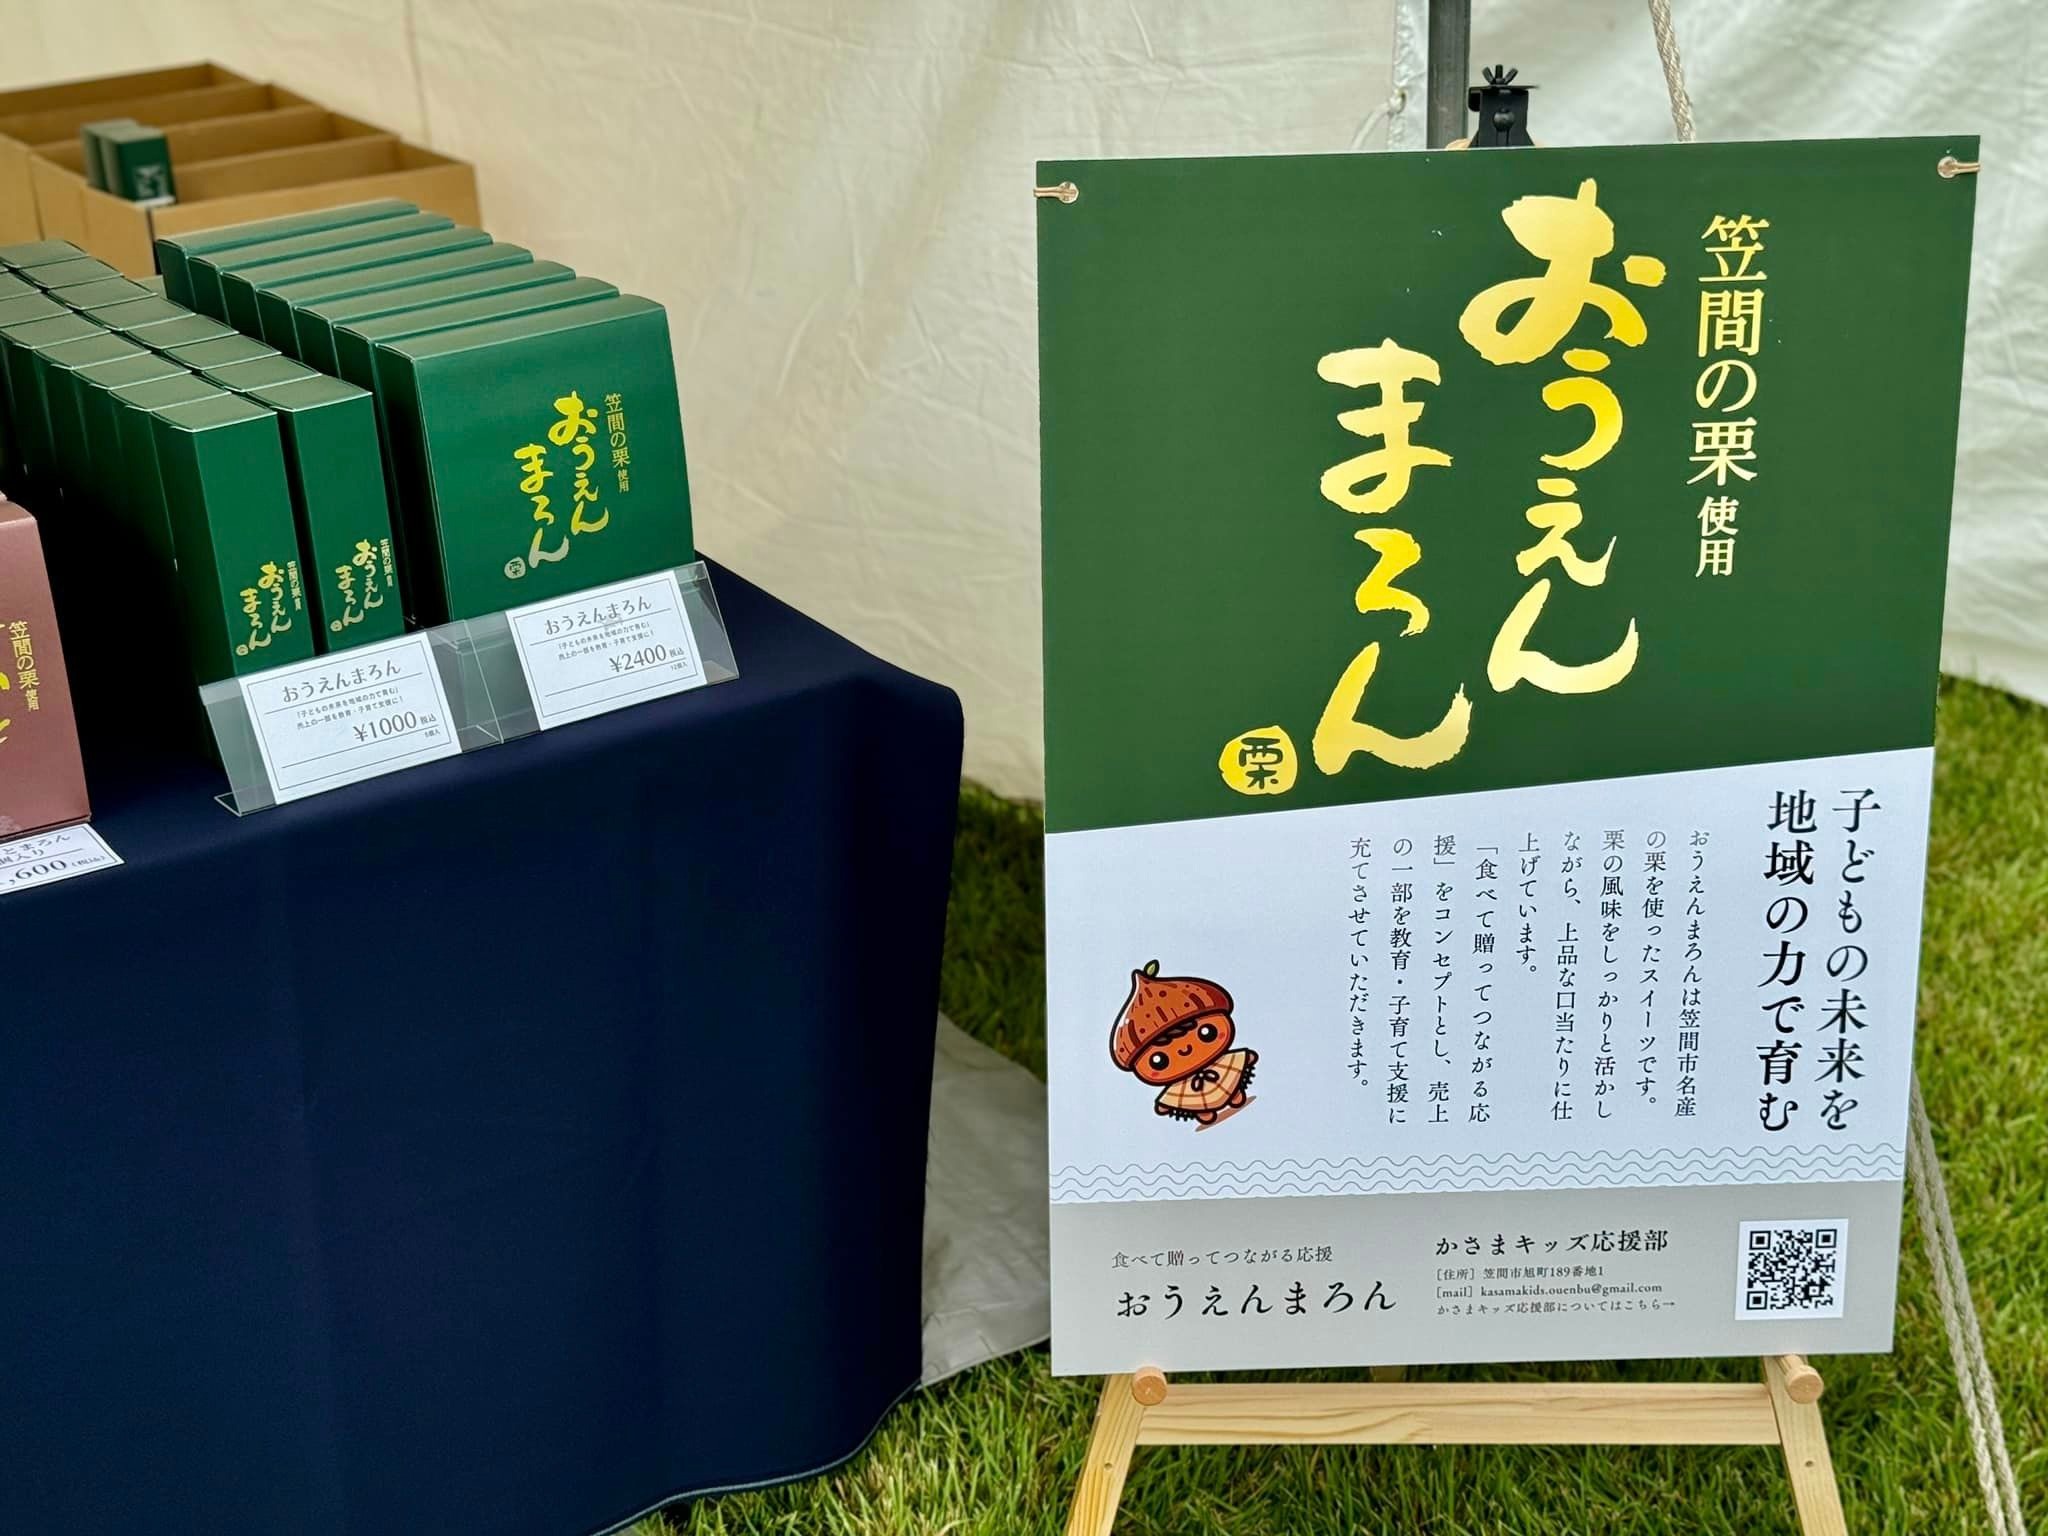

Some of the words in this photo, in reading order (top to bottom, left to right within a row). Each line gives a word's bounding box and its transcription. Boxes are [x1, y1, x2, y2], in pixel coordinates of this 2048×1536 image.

[548, 390, 611, 536] おうえん
[1458, 179, 1666, 695] おうえん
[514, 443, 570, 569] まろん
[258, 561, 292, 634] おうえん
[335, 565, 364, 627] まろん
[352, 539, 384, 610] おうえん
[1313, 337, 1473, 776] まろん
[240, 588, 272, 650] まろん
[544, 595, 652, 636] おうえんまろん
[609, 644, 667, 673] ¥2400
[282, 660, 401, 703] おうえんまろん
[353, 711, 417, 742] ¥1000
[1233, 734, 1284, 791] 栗
[0, 860, 67, 885] ,600
[1516, 832, 1542, 974] 上げています。
[1346, 837, 1372, 1086] 充てさせていただきます。
[1387, 837, 1414, 1125] の一部を教育・子育て支援に
[1428, 834, 1456, 1125] 援」をコンセプトとし、売上
[1467, 842, 1498, 1124] 「食べて贈ってつながる応
[1550, 832, 1583, 1121] ながら、上品な口当たりに仕
[1594, 829, 1625, 1119] 栗の風味をしっかりと活かし
[1635, 831, 1667, 1106] の栗を使ったスイーツです。
[1674, 831, 1711, 1118] おうえんまろんは笠間市名産
[1757, 790, 1817, 1132] 地域の力で育む
[1815, 788, 1882, 1131] 子どもの未来を
[1112, 1246, 1333, 1269] 食べて贈ってつながる応援
[1436, 1230, 1669, 1256] かさまキッズ応援部
[1480, 1283, 1663, 1297] kasamakids.ouenbu@gmail.com
[1483, 1265, 1604, 1281] 笠間市旭町189番地1
[1117, 1281, 1397, 1320] おうえんまろん
